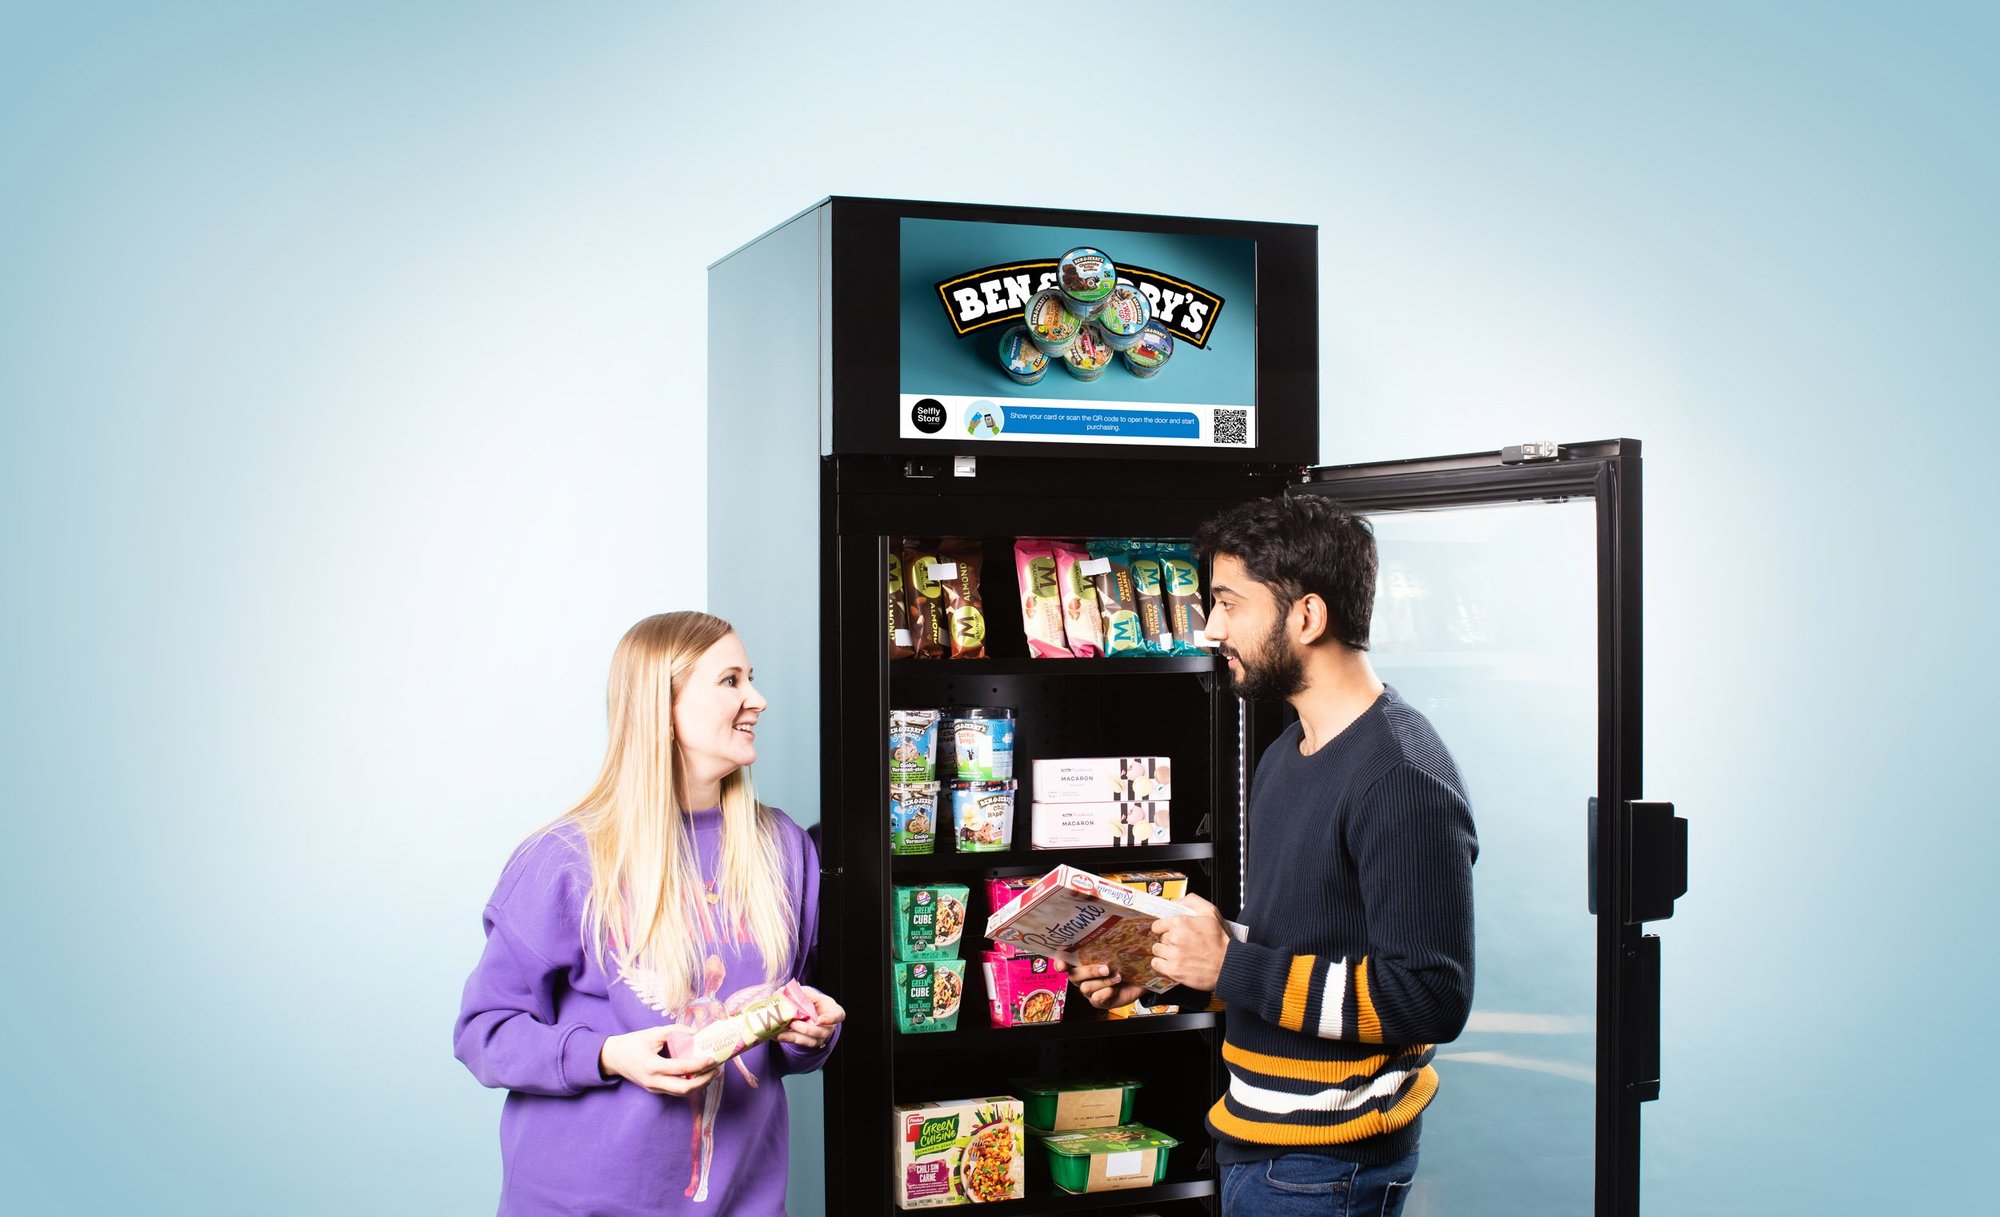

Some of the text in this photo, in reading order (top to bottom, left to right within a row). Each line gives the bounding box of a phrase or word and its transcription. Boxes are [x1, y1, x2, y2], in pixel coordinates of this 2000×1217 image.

[953, 274, 1031, 322] BEN
[917, 406, 941, 417] Selfly
[917, 414, 941, 423] Store
[1086, 423, 1121, 432] purchasing.
[960, 562, 971, 602] ALMOND
[1031, 563, 1040, 595] MAGNUM
[1037, 566, 1057, 589] M
[1074, 564, 1083, 594] MAGNUM
[1116, 572, 1126, 601] VANILLA
[1121, 570, 1131, 602] CARAMEL
[1143, 568, 1160, 587] M
[1175, 567, 1194, 587] M
[956, 615, 976, 639] M
[1152, 604, 1160, 634] VANILLA
[1175, 604, 1183, 635] CARAMEL
[1181, 604, 1189, 633] VANILLA
[1113, 619, 1132, 642] M
[913, 914, 933, 925] CUBE
[914, 906, 931, 915] GREEN
[1022, 904, 1106, 951] Ristorante
[910, 987, 930, 997] CUBE
[911, 980, 929, 988] GREEN
[755, 1003, 787, 1032] M
[713, 1039, 737, 1053] WHITE
[916, 1164, 930, 1174] CHILI
[920, 1173, 937, 1183] CARNE
